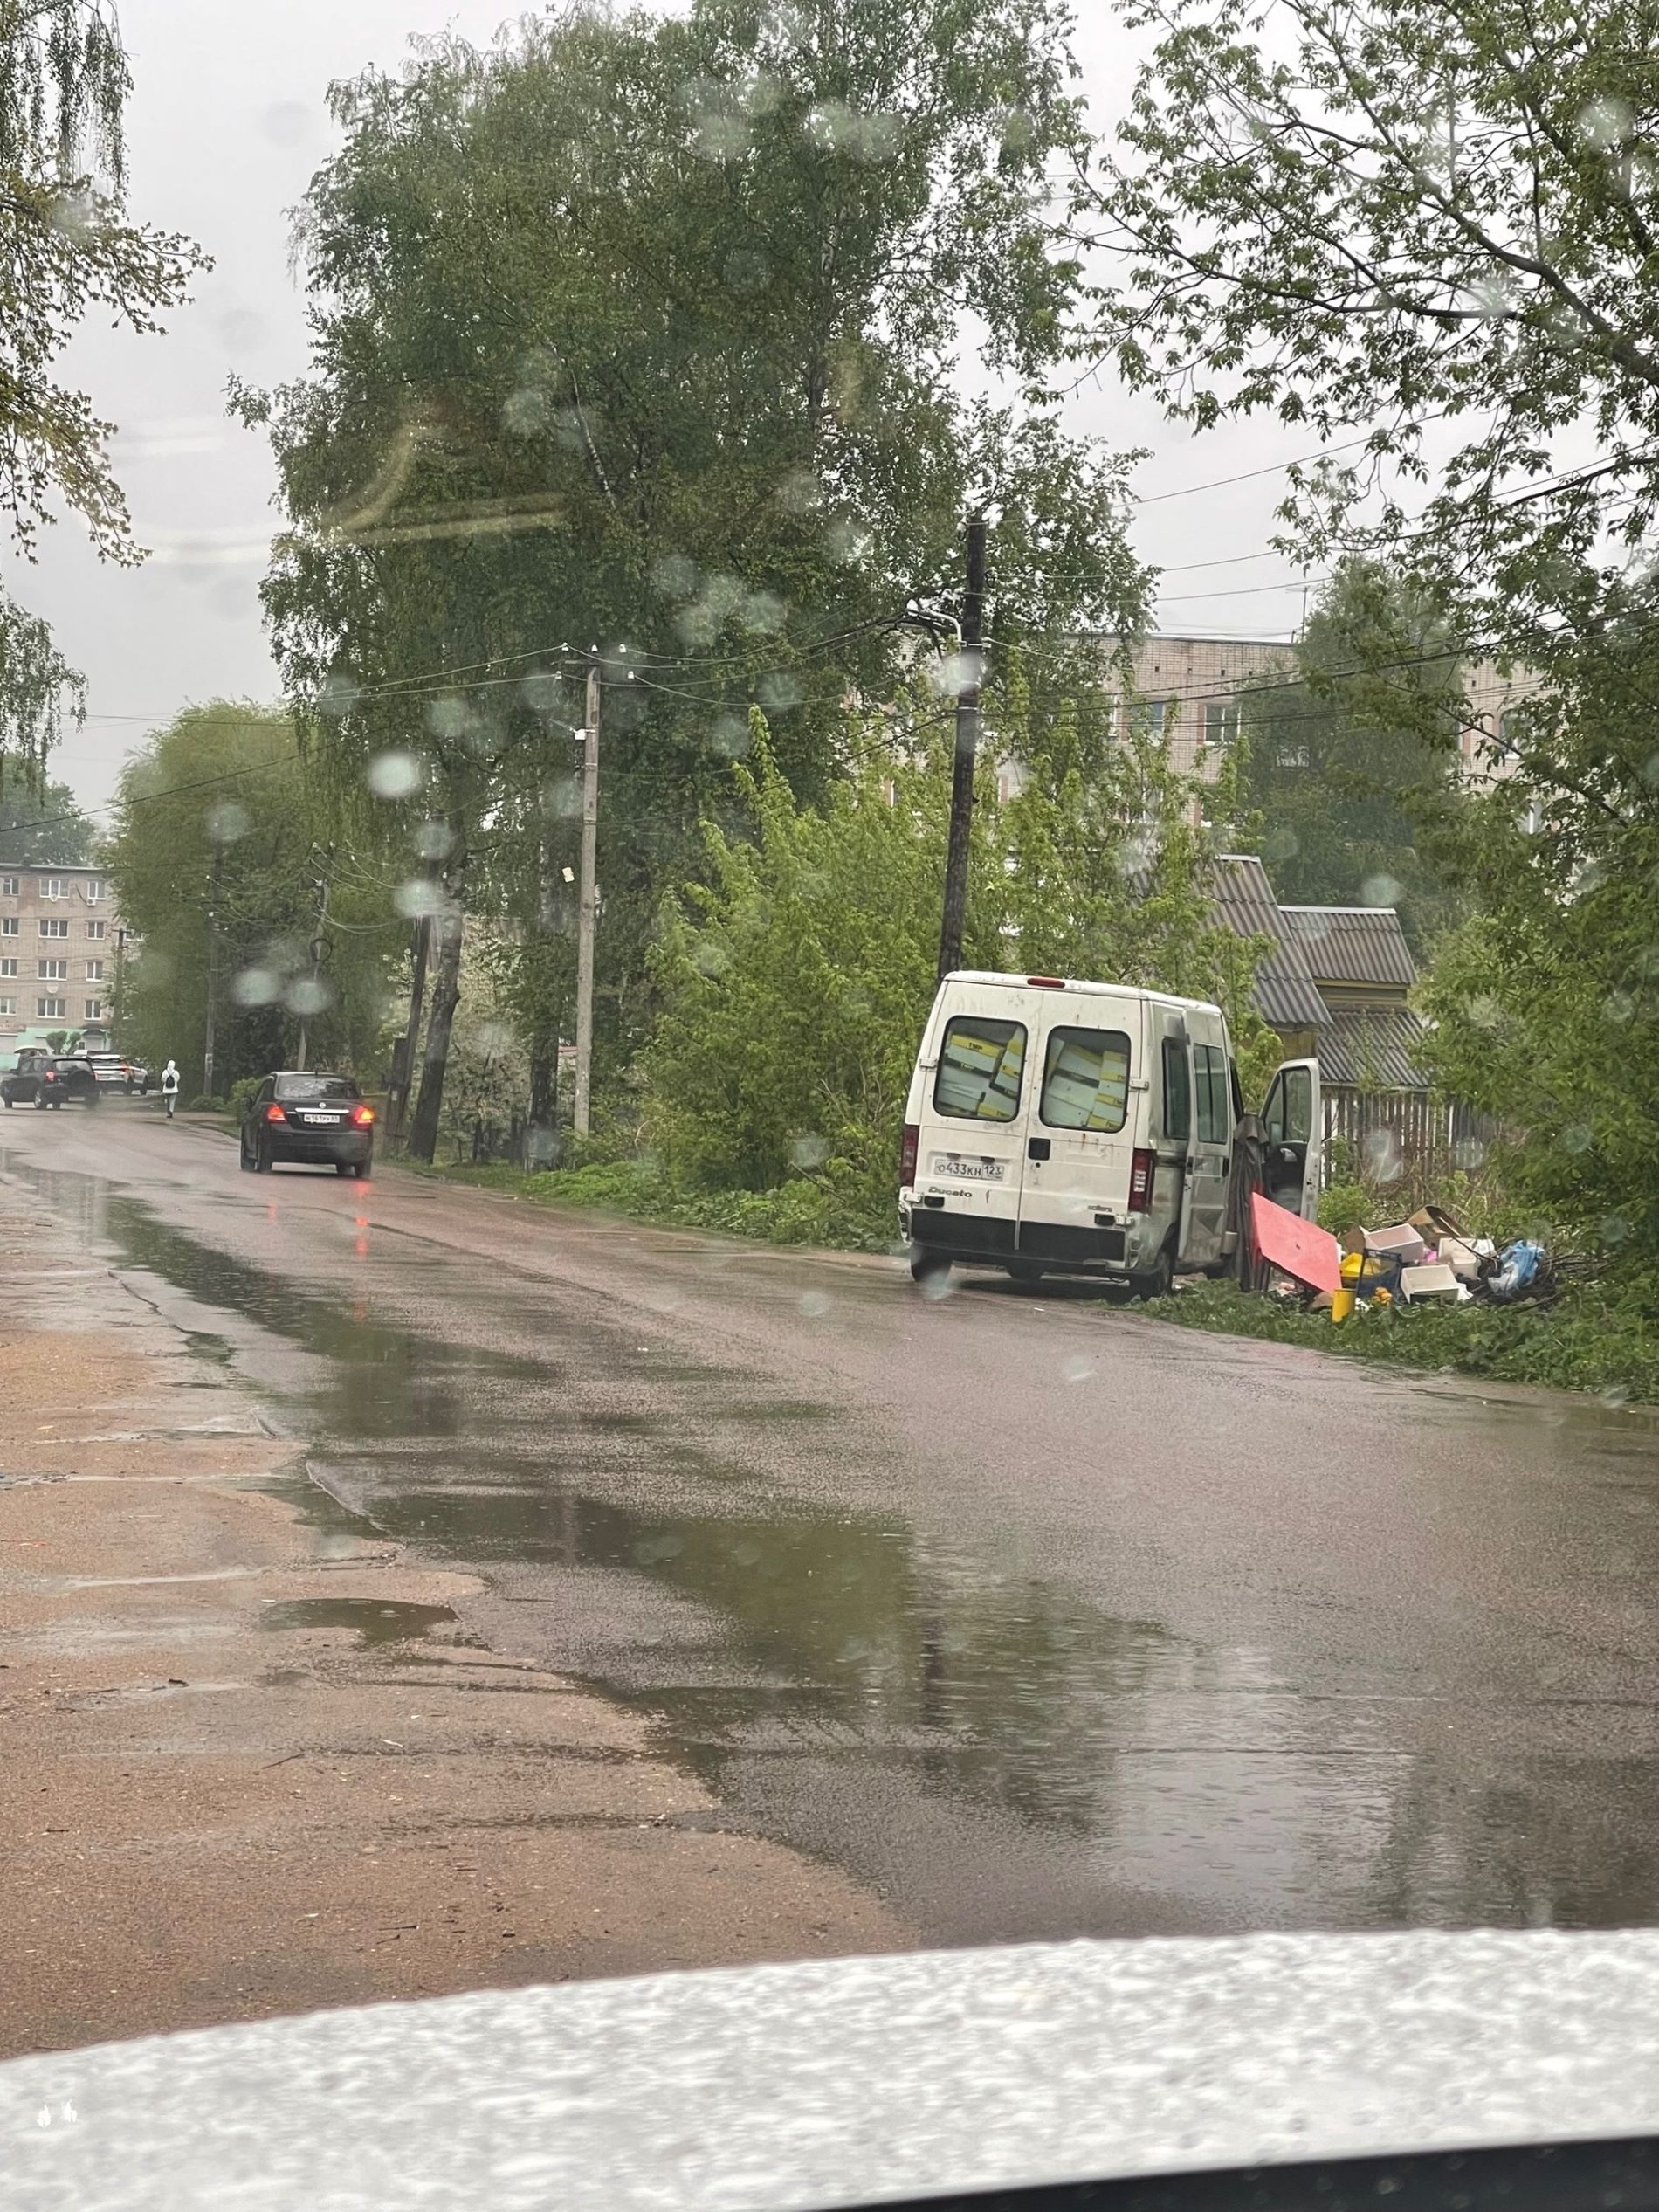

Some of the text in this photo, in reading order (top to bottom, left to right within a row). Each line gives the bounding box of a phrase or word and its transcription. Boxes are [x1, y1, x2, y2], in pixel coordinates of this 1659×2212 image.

[938, 1162, 1002, 1176] О433КН 123
[928, 1186, 973, 1197] Ducato
